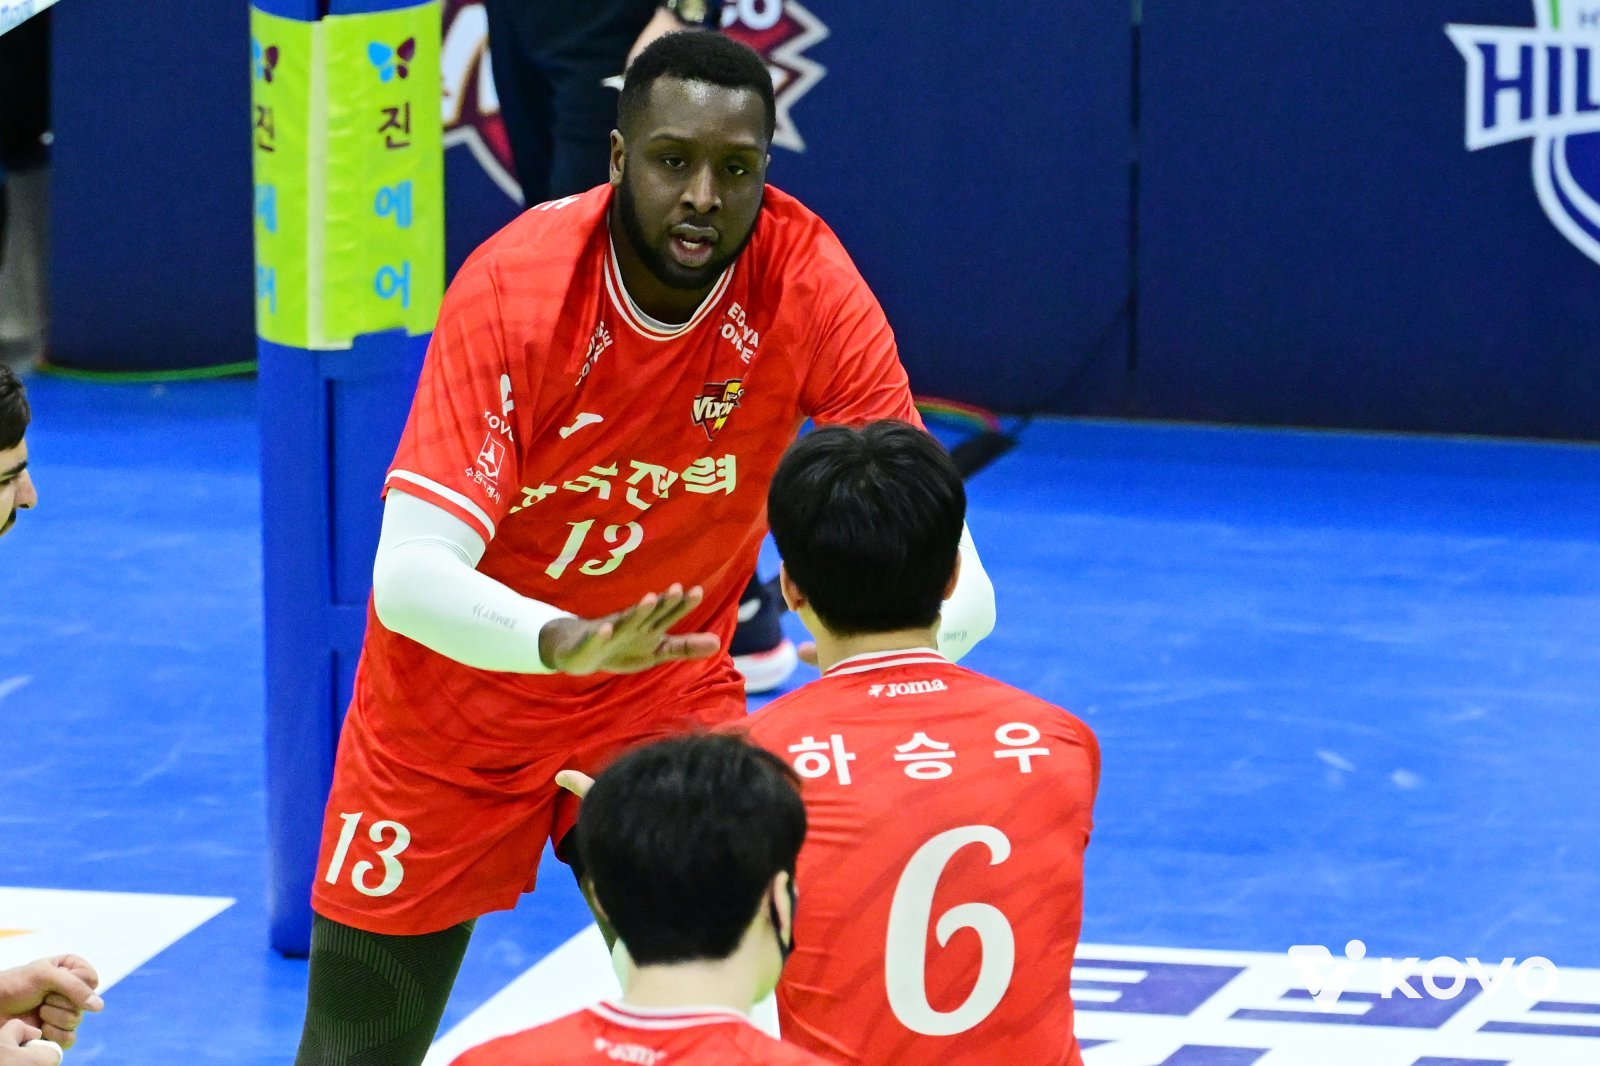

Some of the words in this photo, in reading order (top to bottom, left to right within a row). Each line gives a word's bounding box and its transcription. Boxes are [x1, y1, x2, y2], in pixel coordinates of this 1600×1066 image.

[545, 519, 645, 580] 13
[325, 811, 411, 897] 13
[884, 824, 1015, 1037] 6
